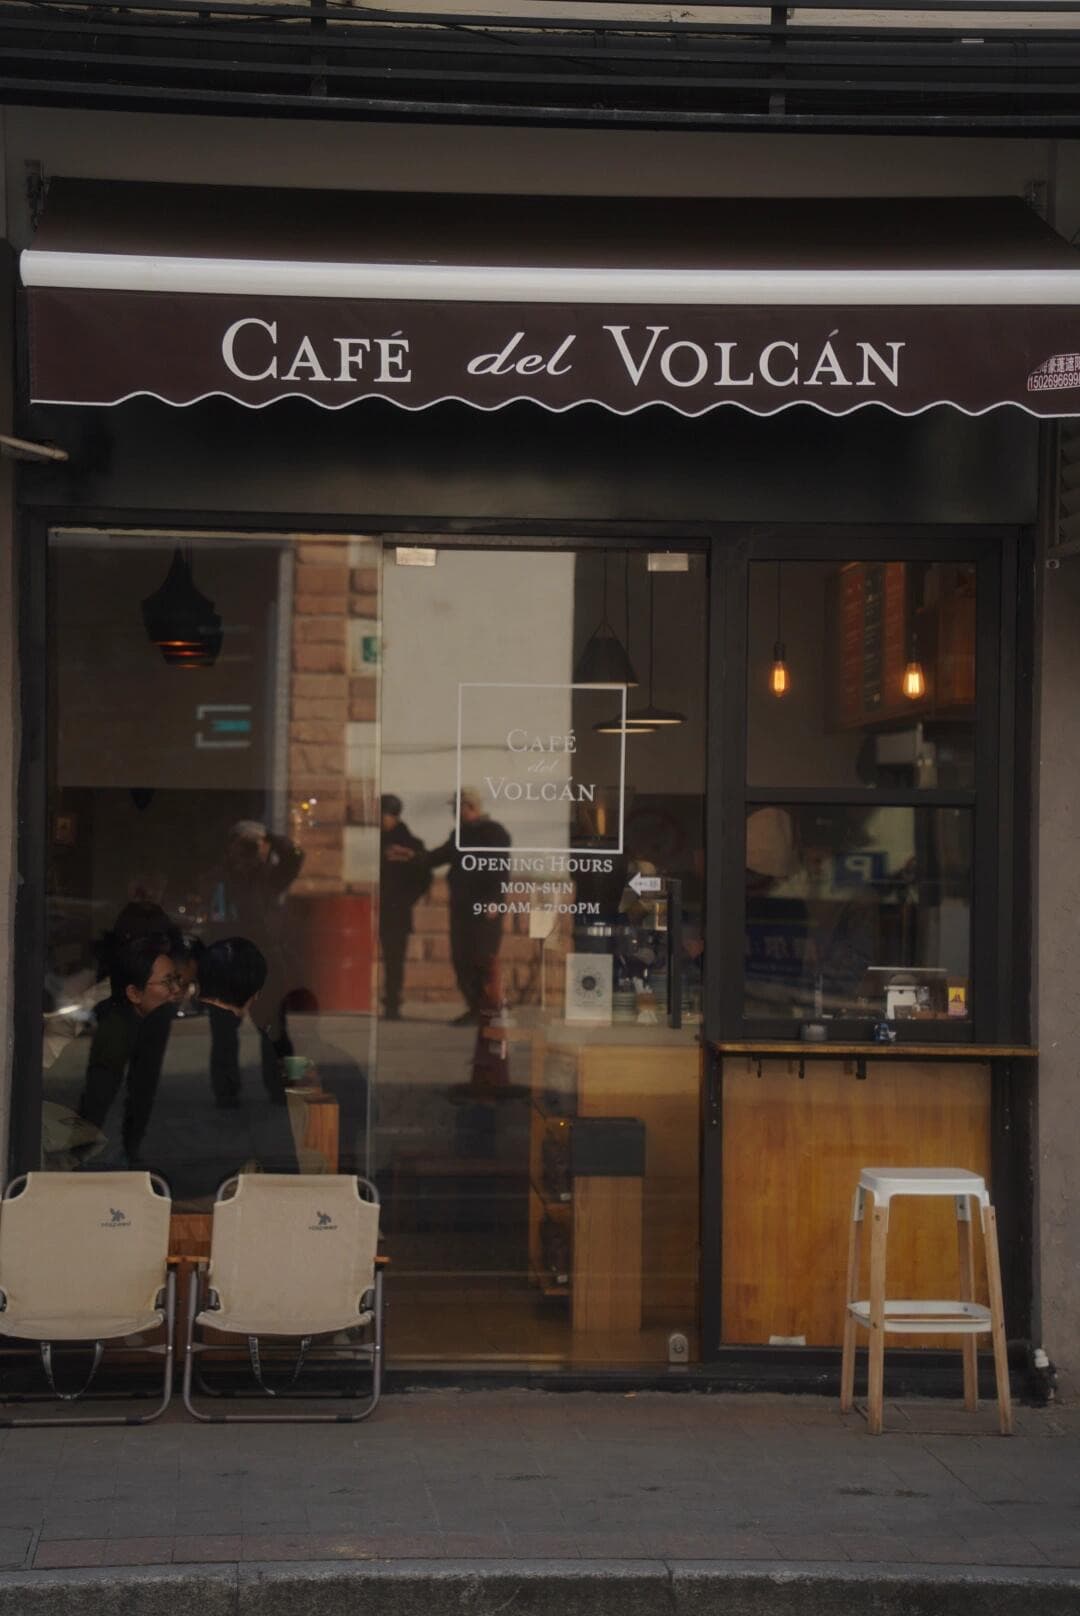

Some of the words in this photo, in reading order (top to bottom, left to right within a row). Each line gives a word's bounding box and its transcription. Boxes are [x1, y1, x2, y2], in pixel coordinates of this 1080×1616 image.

[221, 317, 412, 383] CAFÉ
[466, 331, 577, 376] del
[602, 325, 906, 388] VOLCÁN
[1030, 372, 1080, 389] 1502696699
[505, 728, 577, 754] CAFÉ
[526, 758, 561, 774] del
[484, 775, 597, 802] VOLCÁN
[461, 854, 544, 872] OPENING
[551, 856, 614, 873] HOURS
[500, 881, 574, 895] MON-SUN
[472, 901, 531, 915] 9:00AM
[543, 902, 601, 914] 7:00PM
